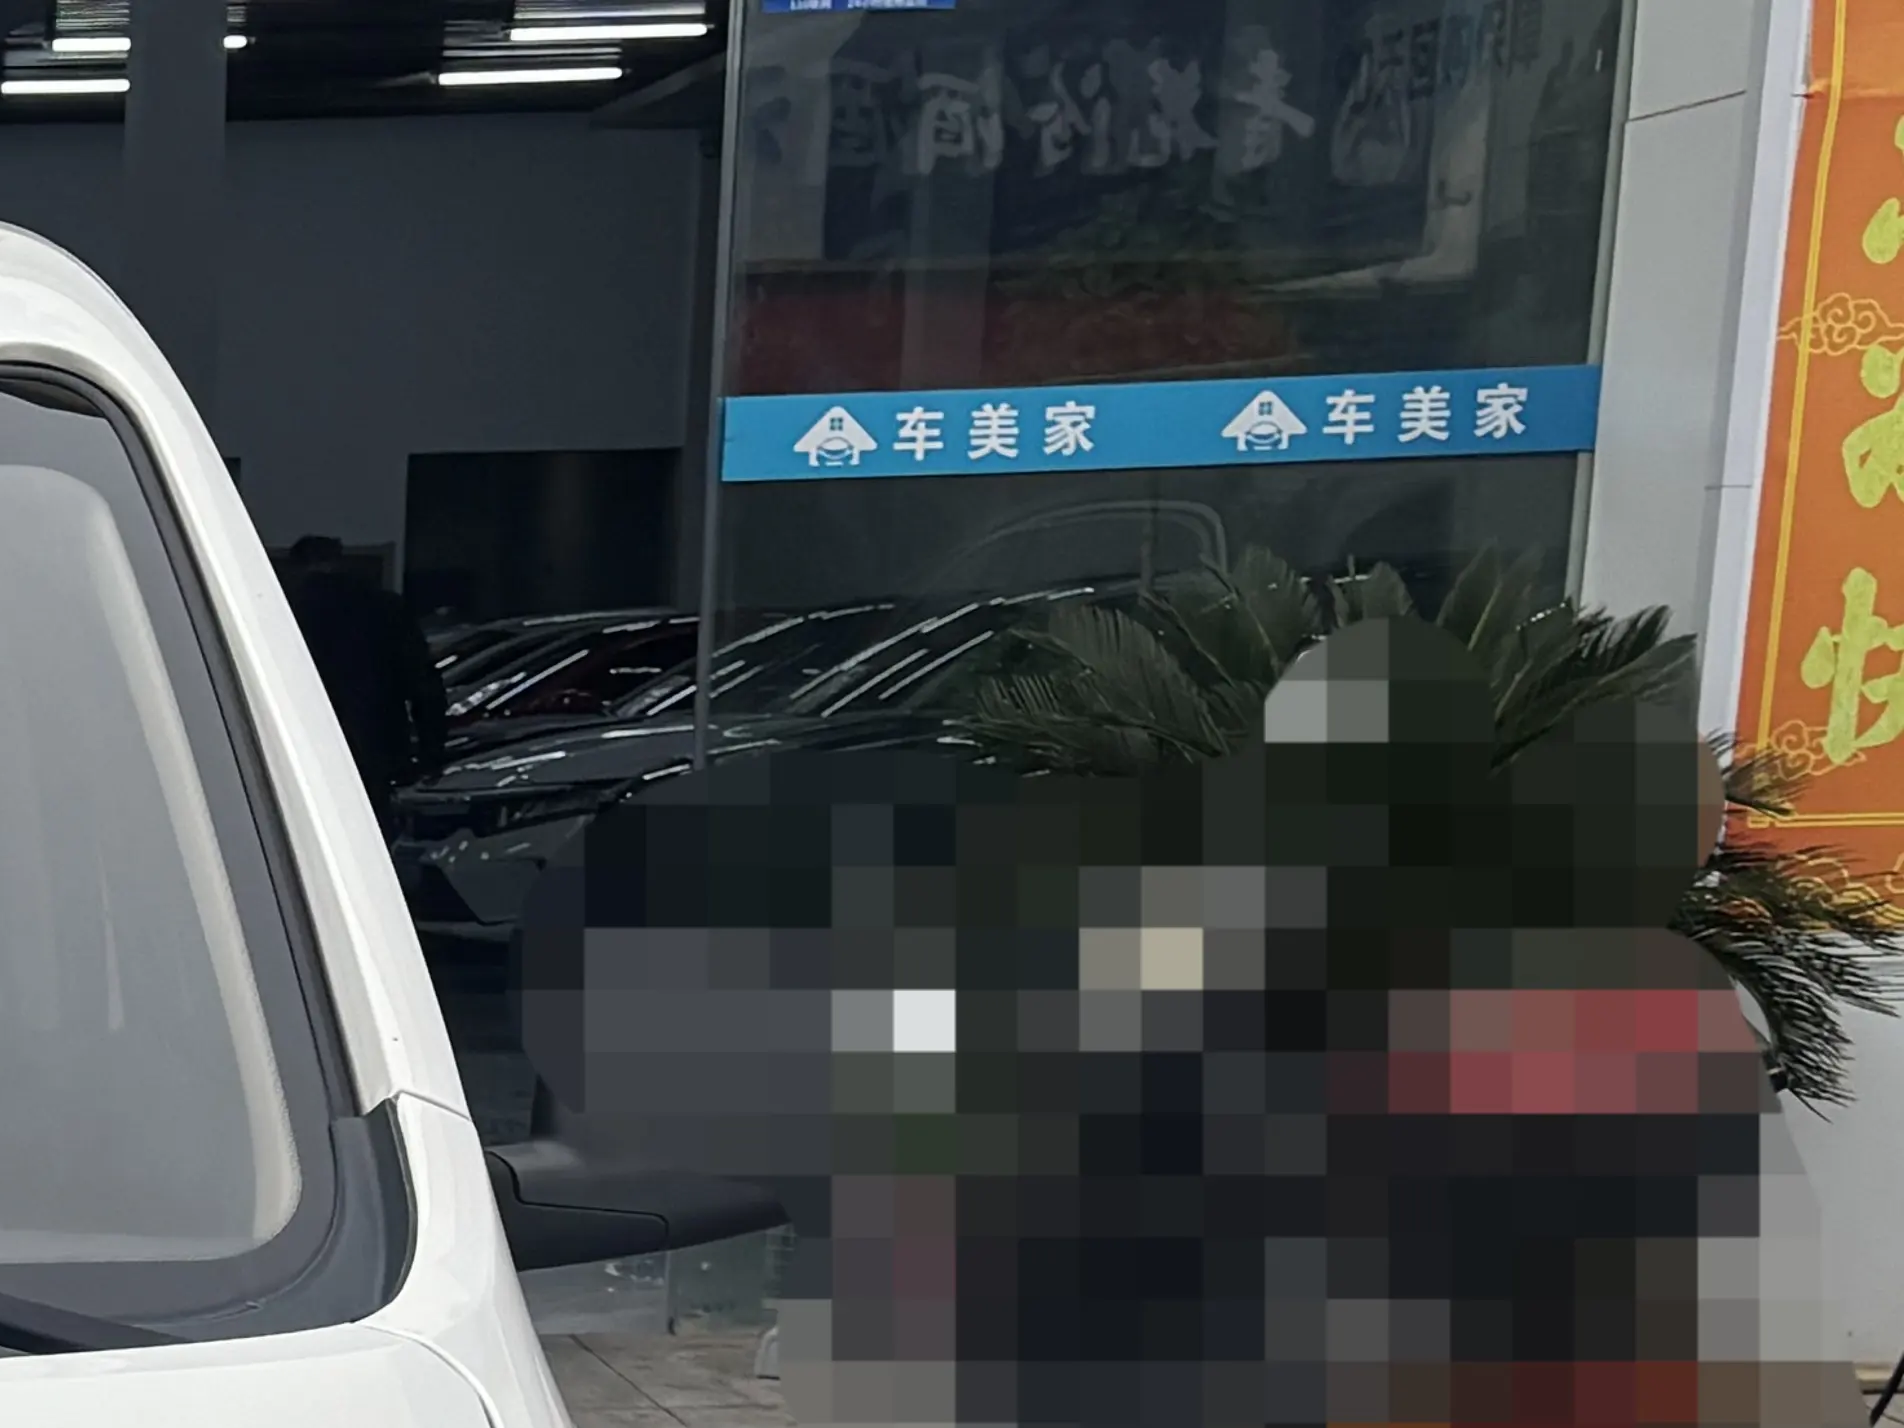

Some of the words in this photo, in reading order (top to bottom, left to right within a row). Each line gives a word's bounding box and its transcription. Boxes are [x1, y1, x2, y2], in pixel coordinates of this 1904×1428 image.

[893, 401, 1096, 461] 车美家
[1322, 383, 1528, 445] 车美家
